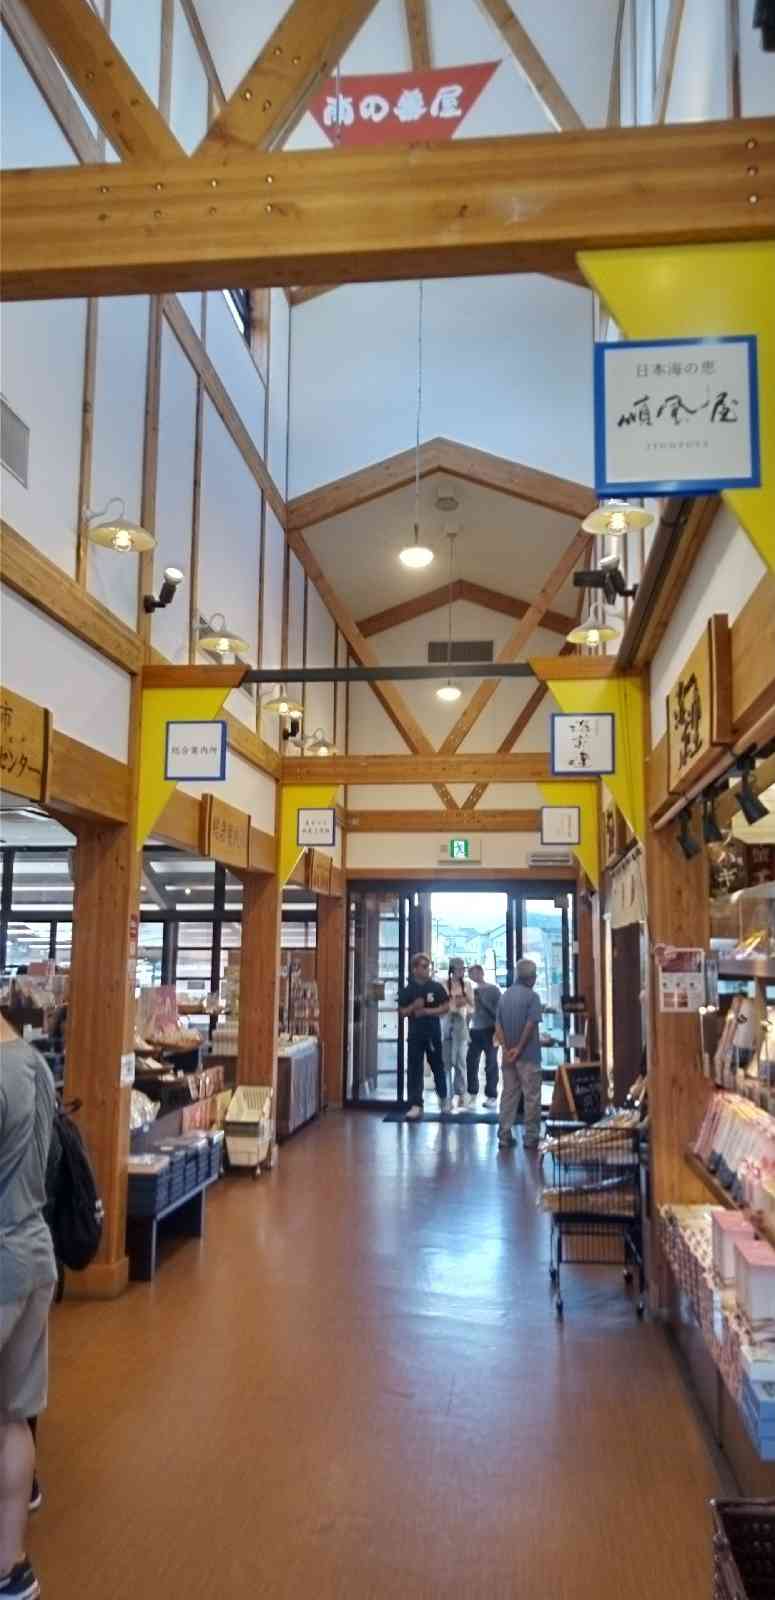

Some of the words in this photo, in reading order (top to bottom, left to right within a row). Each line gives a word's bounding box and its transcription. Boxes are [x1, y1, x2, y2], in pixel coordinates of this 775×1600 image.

[635, 360, 717, 377] 日本海の恵
